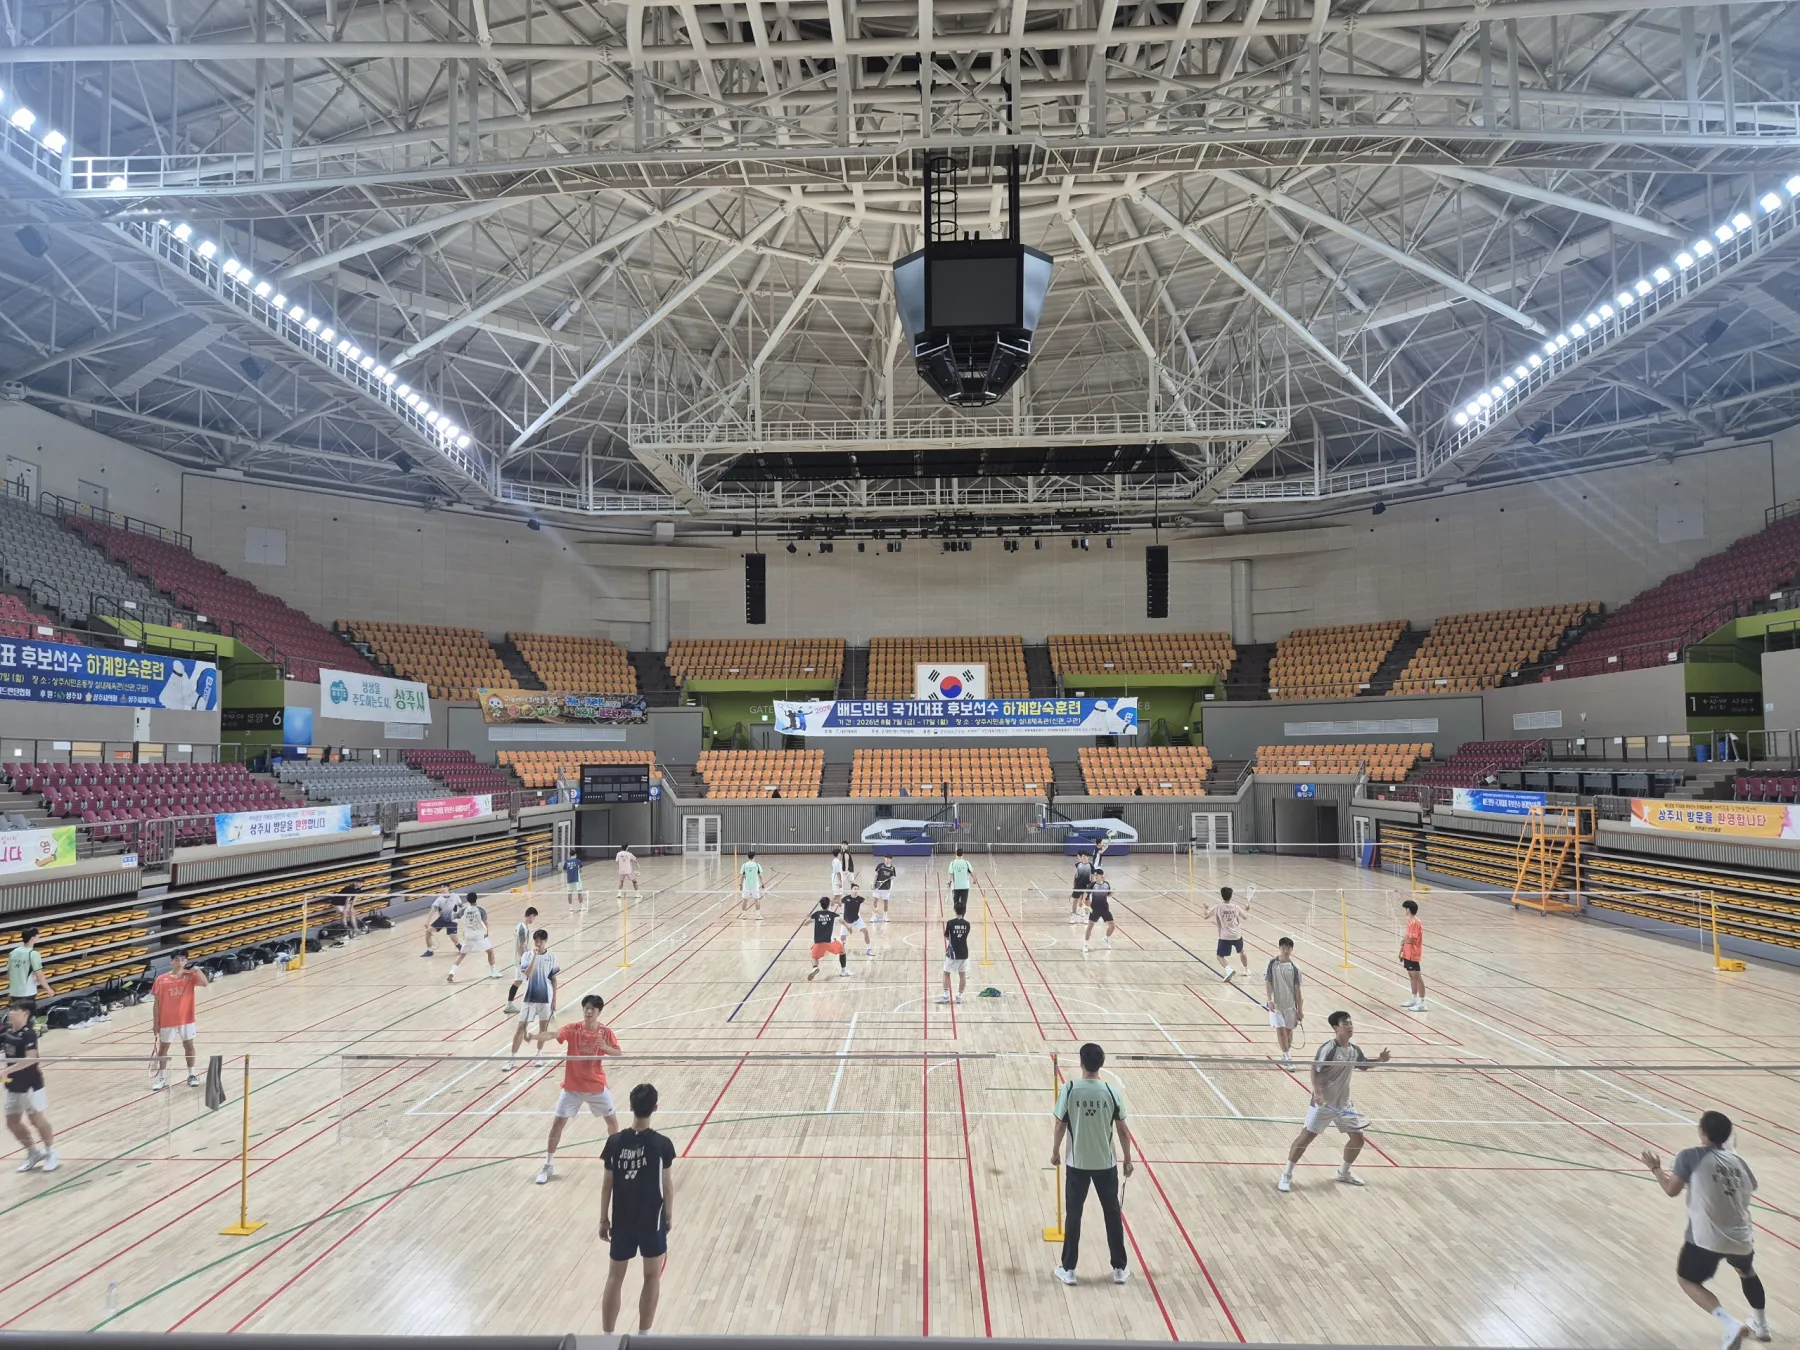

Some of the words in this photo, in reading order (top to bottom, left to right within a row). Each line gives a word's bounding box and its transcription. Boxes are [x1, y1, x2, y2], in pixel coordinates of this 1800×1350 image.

[21, 645, 83, 673] 후보선수
[86, 653, 165, 681] 하계합숙훈련
[394, 689, 425, 711] 상주시
[1689, 696, 1697, 712] 1
[749, 705, 774, 714] GATE
[815, 704, 832, 714] 2026
[837, 702, 888, 717] 배드민턴
[892, 702, 944, 717] 국가대표
[947, 701, 1000, 716] 후보선수
[1002, 700, 1081, 716] 하계합숙훈련
[272, 710, 282, 726] 6
[1658, 809, 1683, 822] 상주시
[1686, 811, 1713, 825] 방문을
[1717, 812, 1767, 827] 환영합니다
[249, 822, 271, 836] 상주시
[273, 819, 293, 833] 방문을
[1076, 1100, 1108, 1109] KOREA
